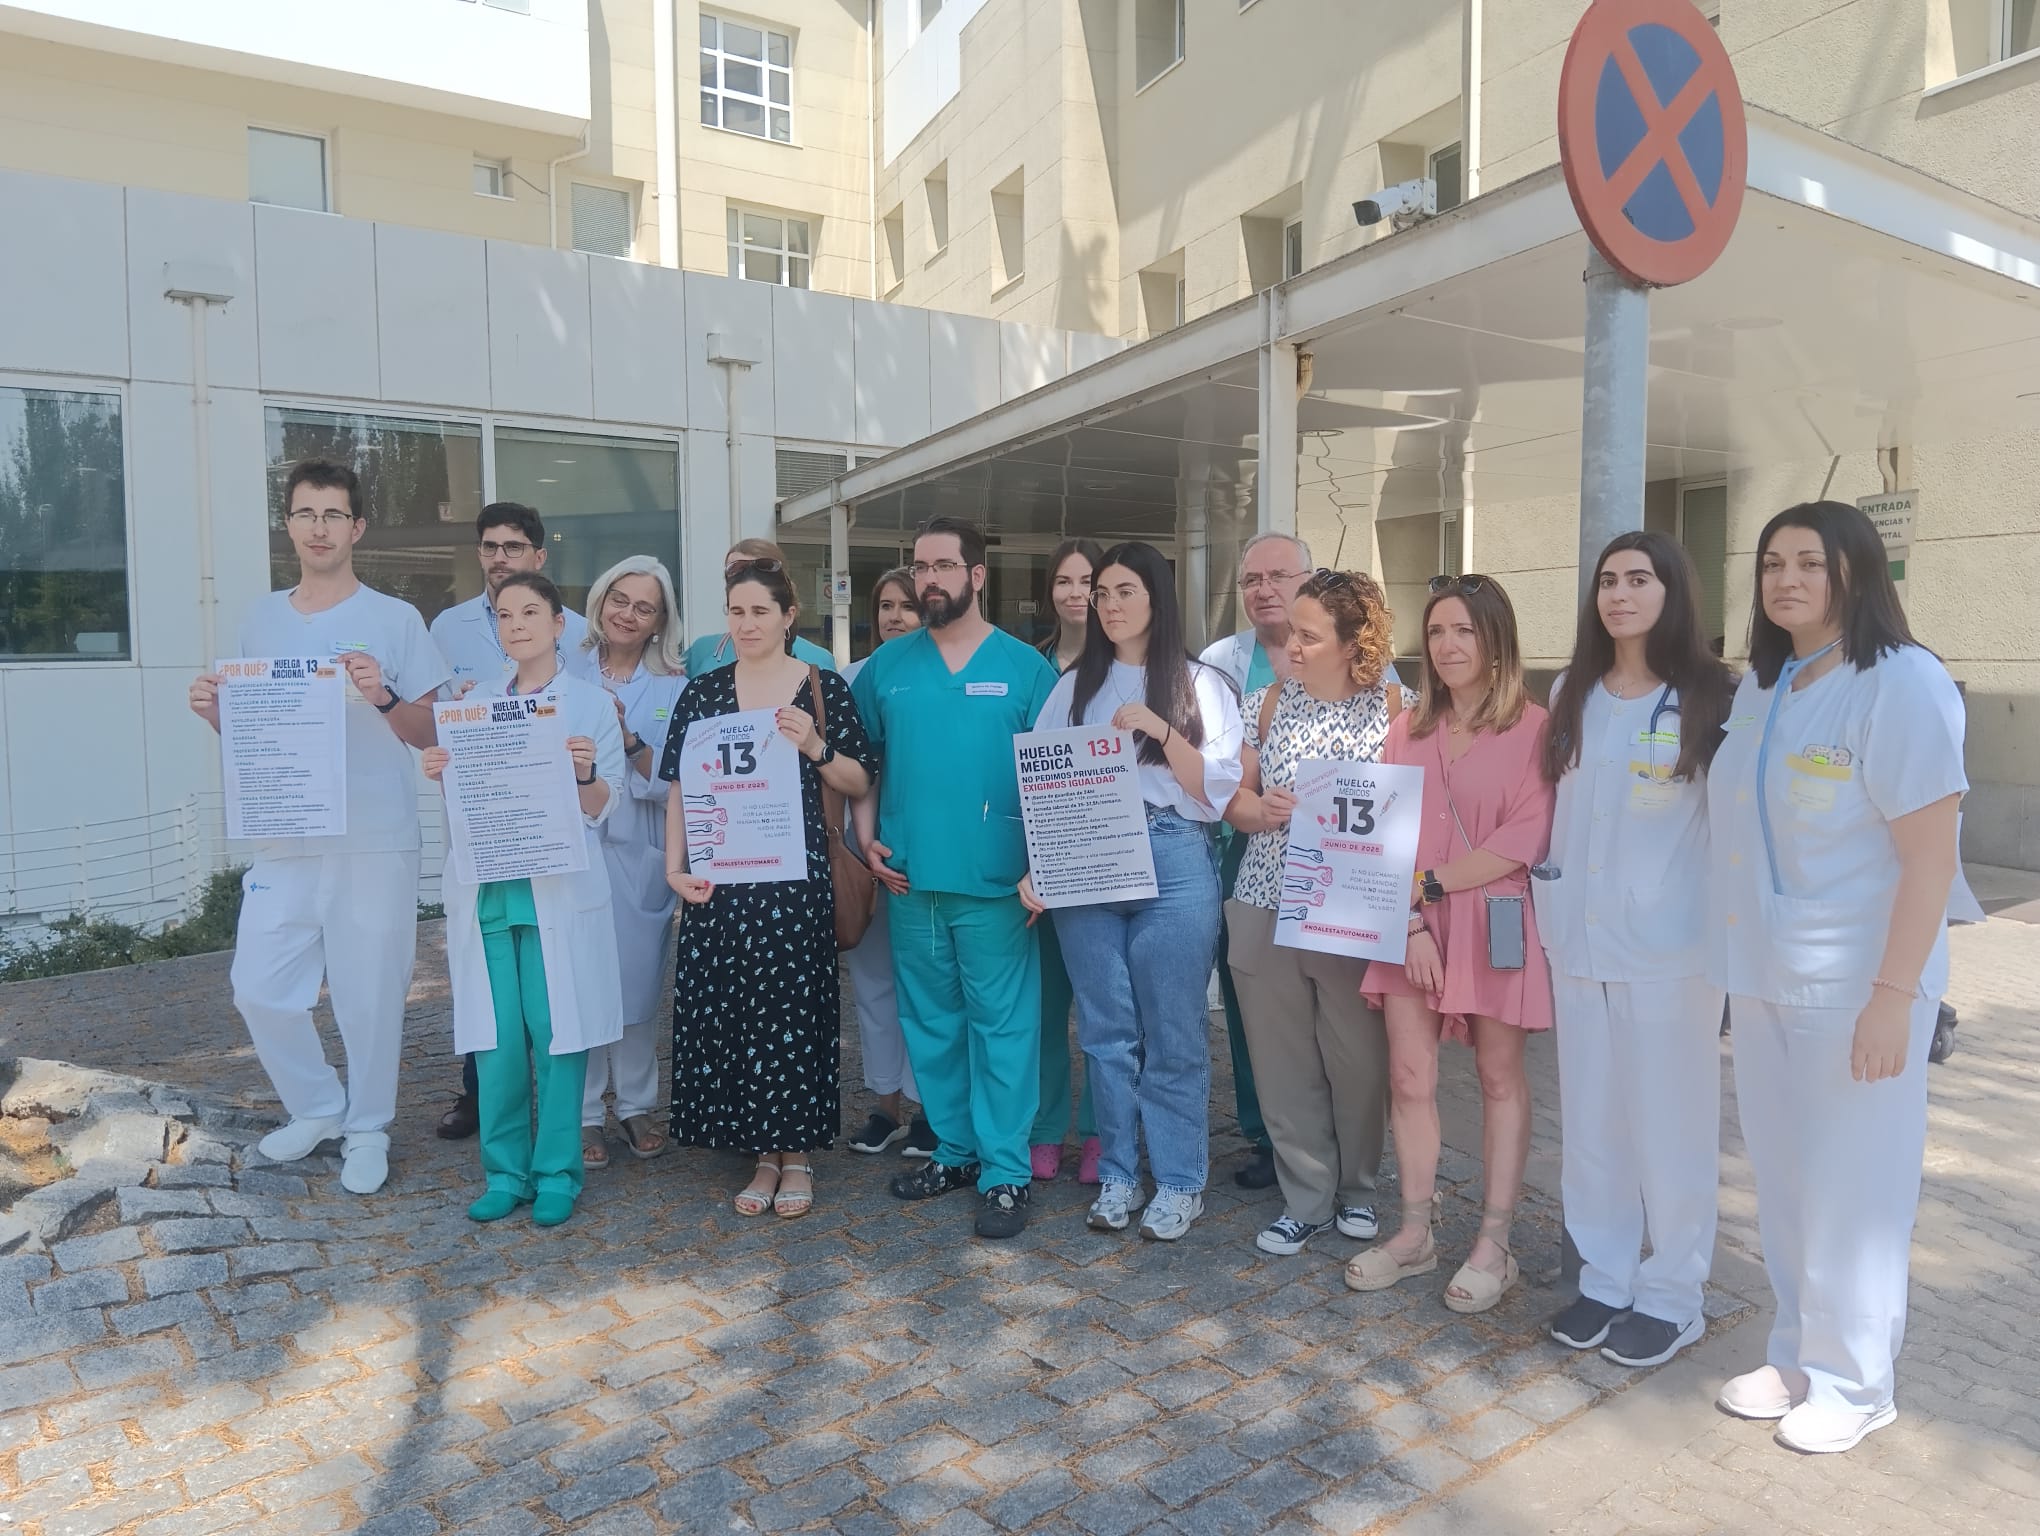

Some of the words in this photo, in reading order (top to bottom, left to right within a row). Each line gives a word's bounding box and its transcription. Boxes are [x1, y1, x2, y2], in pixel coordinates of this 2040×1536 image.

[1862, 500, 1911, 515] ENTRADA
[1872, 518, 1903, 527] ENCIAS
[244, 661, 268, 676] QUÉ?
[274, 659, 301, 669] HUELGA
[306, 660, 318, 673] 13
[271, 669, 305, 679] NACIONAL
[492, 700, 520, 713] HUELGA
[523, 699, 538, 714] 13
[439, 708, 462, 724] ¿POR
[464, 704, 488, 722] QUÉ?
[492, 710, 526, 723] NACIONAL
[720, 725, 755, 735] HUELGA
[1019, 743, 1074, 760] HUELGA
[1087, 736, 1122, 757] 13J
[717, 742, 757, 776] 13
[1020, 757, 1074, 774] MÉDICA
[1022, 776, 1034, 784] NO
[1035, 772, 1072, 783] PEDIMOS
[1023, 781, 1067, 793] EXIGIMOS
[1069, 775, 1116, 788] IGUALDAD
[1336, 778, 1376, 789] HUELGA
[1339, 788, 1370, 797] MÉDICOS
[1333, 796, 1375, 836] 13
[713, 858, 780, 868] #NOALESTATUTOMARCO
[1304, 924, 1378, 940] #NOALESTATUTOMARCO
